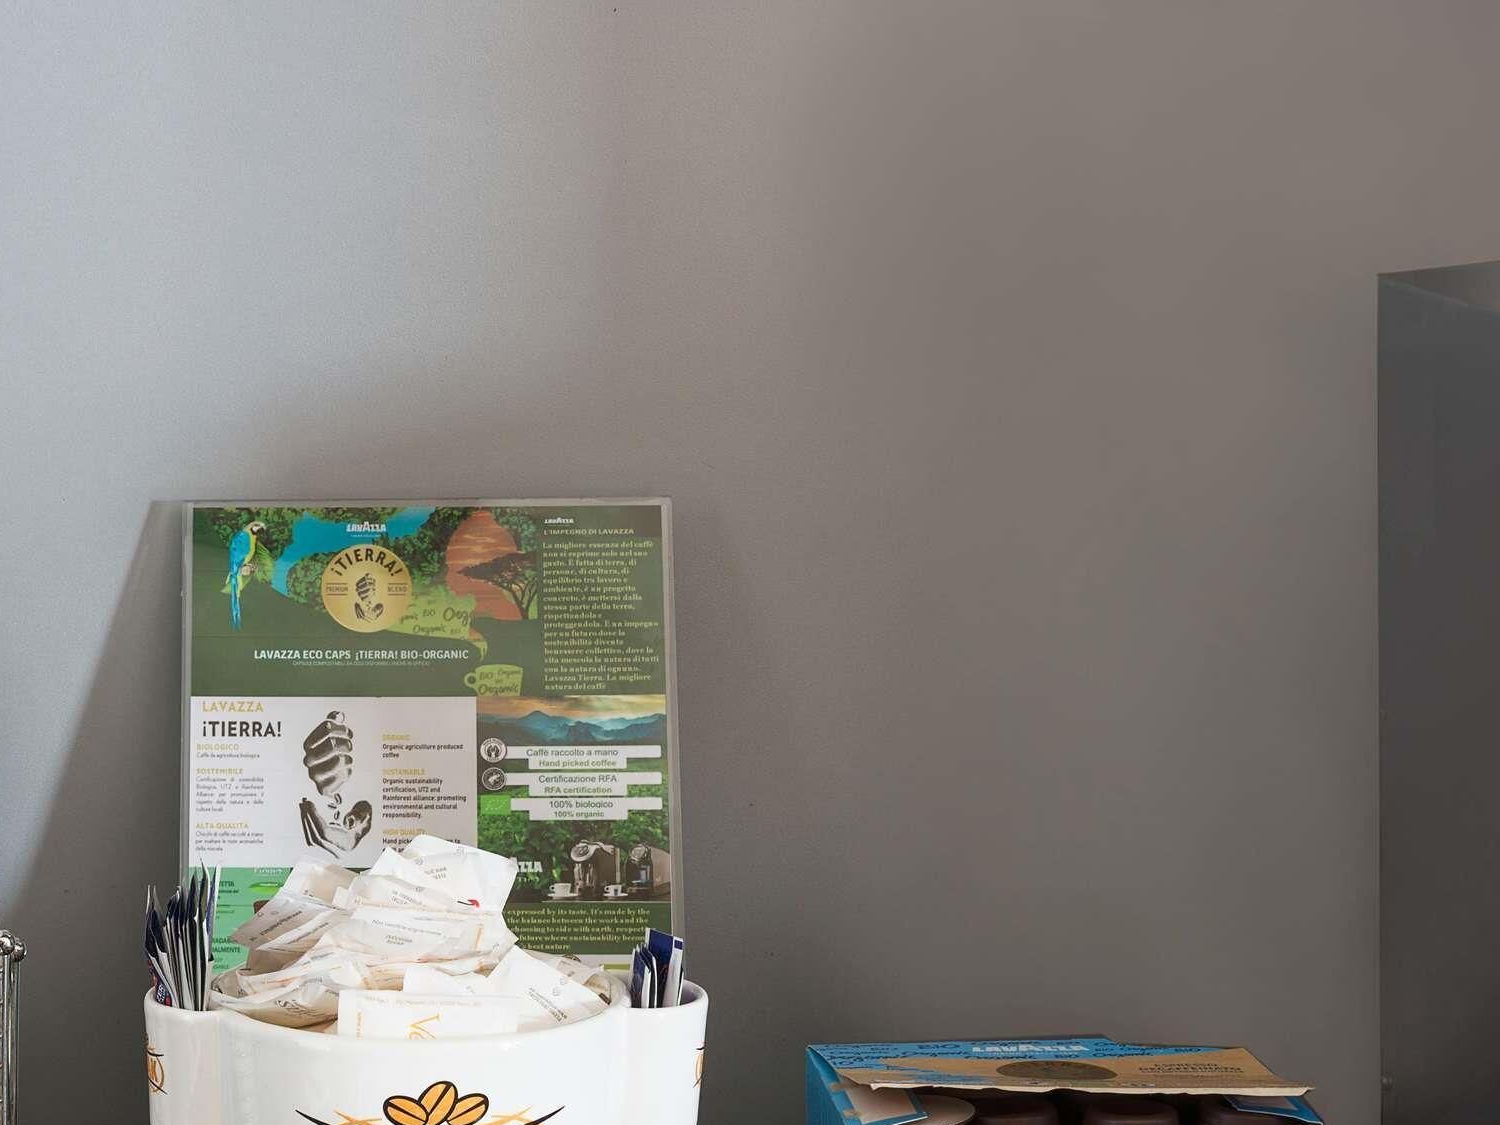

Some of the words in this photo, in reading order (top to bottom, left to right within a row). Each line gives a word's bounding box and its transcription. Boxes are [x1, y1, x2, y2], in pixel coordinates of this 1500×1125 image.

[254, 650, 300, 659] LAVAZZA
[303, 650, 323, 659] ECO
[325, 650, 351, 659] CAPS
[355, 651, 398, 661] ¡TIERRA!
[400, 650, 469, 659] BIO-ORGANIC
[203, 701, 264, 712] LAVAZZA
[203, 721, 281, 737] ¡TIERRA!
[526, 748, 548, 757] Caffè
[551, 749, 584, 757] raccolto
[563, 759, 589, 768] picked
[539, 775, 596, 783] Certificazione
[564, 786, 612, 794] certification
[549, 801, 573, 809] 100%
[575, 801, 613, 810] biologico
[576, 811, 605, 819] organic
